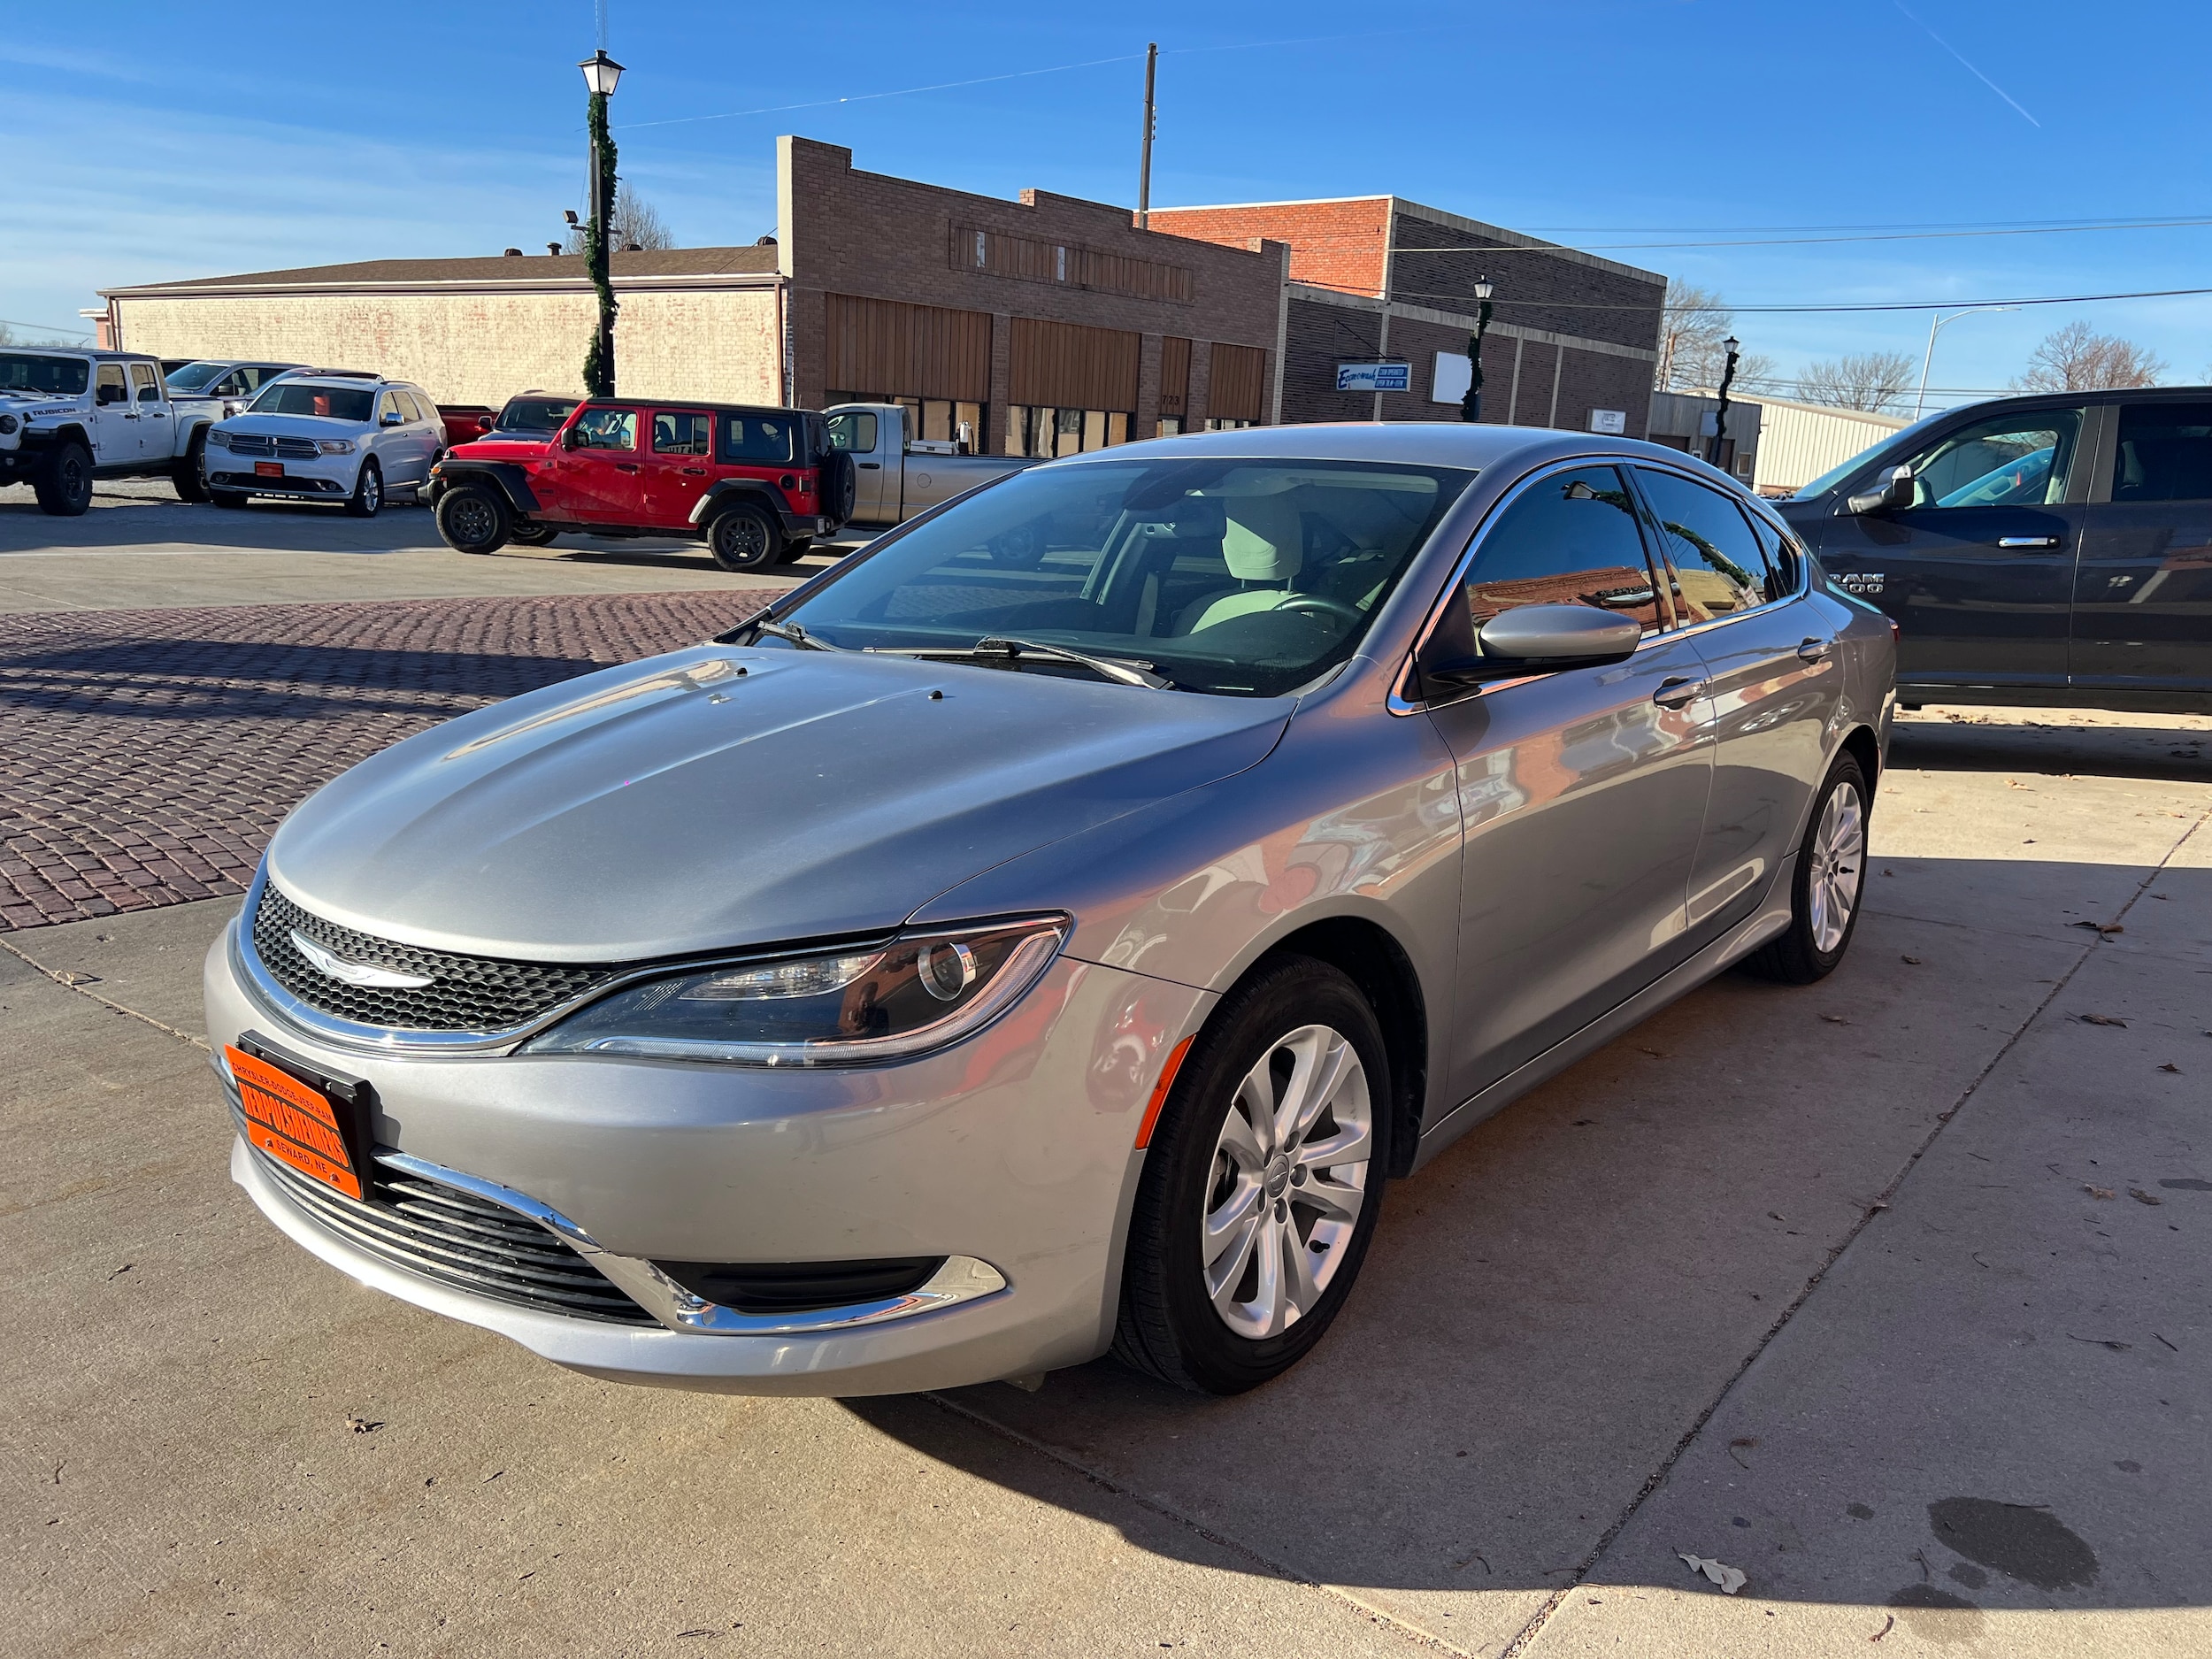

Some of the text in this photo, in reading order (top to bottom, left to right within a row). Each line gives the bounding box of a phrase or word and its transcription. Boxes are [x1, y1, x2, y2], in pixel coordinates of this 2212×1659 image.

[1163, 395, 1179, 405] 723
[276, 1140, 328, 1174] SEWARD, NE
